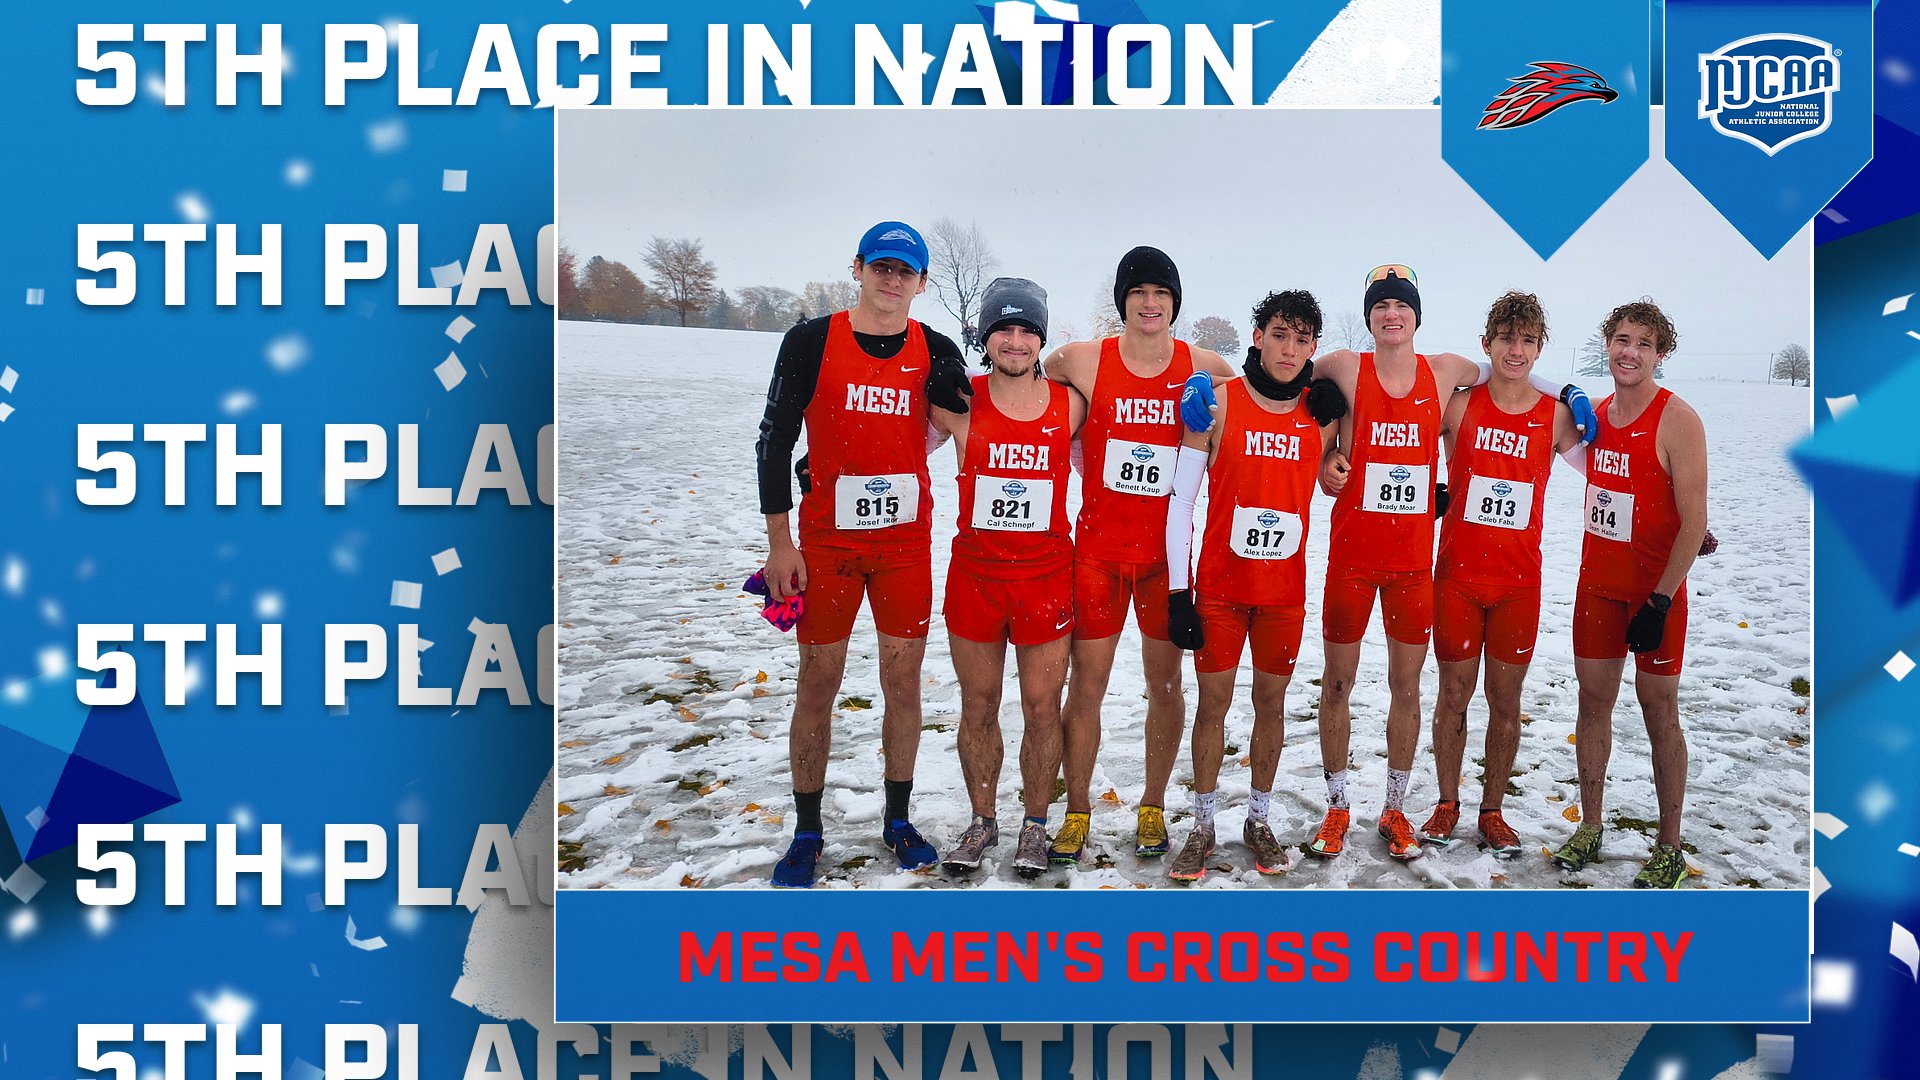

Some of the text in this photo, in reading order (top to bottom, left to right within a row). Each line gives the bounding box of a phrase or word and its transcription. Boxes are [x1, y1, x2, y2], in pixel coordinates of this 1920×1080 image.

[845, 383, 911, 416] MESA
[1115, 397, 1176, 425] MESA
[1368, 421, 1420, 447] MESA
[1474, 426, 1529, 459] MESA
[1245, 430, 1301, 461] MESA
[988, 442, 1050, 471] MESA
[1593, 447, 1630, 478] MESA
[1120, 462, 1160, 484] 816
[1141, 484, 1161, 494] Kaup
[1379, 484, 1416, 502] 819
[855, 497, 899, 517] 815
[991, 499, 1031, 519] 821
[1377, 502, 1398, 511] Brady
[1481, 497, 1516, 517] 813
[856, 518, 880, 526] Josef
[987, 519, 1035, 530] Cal Schnepf
[1477, 514, 1515, 526] Caleb Faba
[1591, 506, 1616, 528] 814
[1246, 528, 1285, 548] 817
[1243, 548, 1282, 557] Alex Lopez
